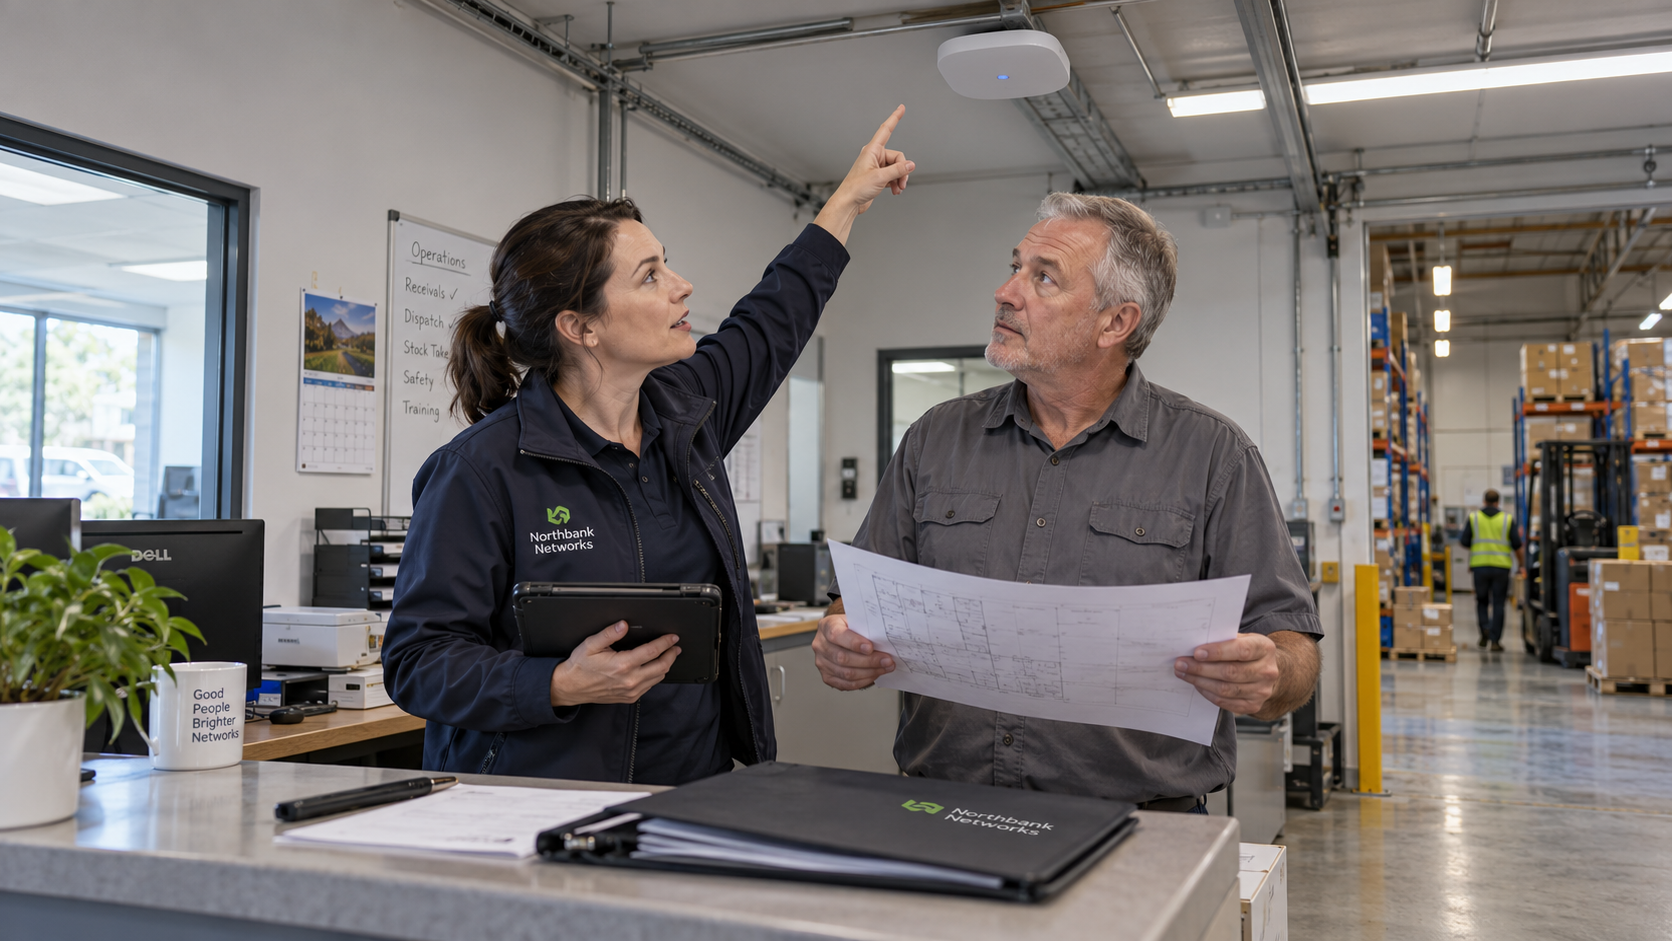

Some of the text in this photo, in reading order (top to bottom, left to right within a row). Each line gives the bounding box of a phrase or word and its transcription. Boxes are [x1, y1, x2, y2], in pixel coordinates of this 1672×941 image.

[411, 240, 466, 269] Operations
[405, 276, 445, 299] Receivals
[404, 308, 444, 331] Dispatch
[404, 340, 449, 359] Stock Take
[403, 369, 434, 392] Safety
[403, 400, 440, 423] Training
[530, 526, 595, 542] Northbank
[131, 549, 172, 562] DELL
[534, 539, 594, 554] Networks
[193, 687, 224, 700] Good
[193, 702, 230, 715] People
[192, 716, 236, 730] Brighter
[192, 729, 239, 743] Networks
[944, 814, 1040, 836] Networks
[951, 807, 1054, 831] Northbank
